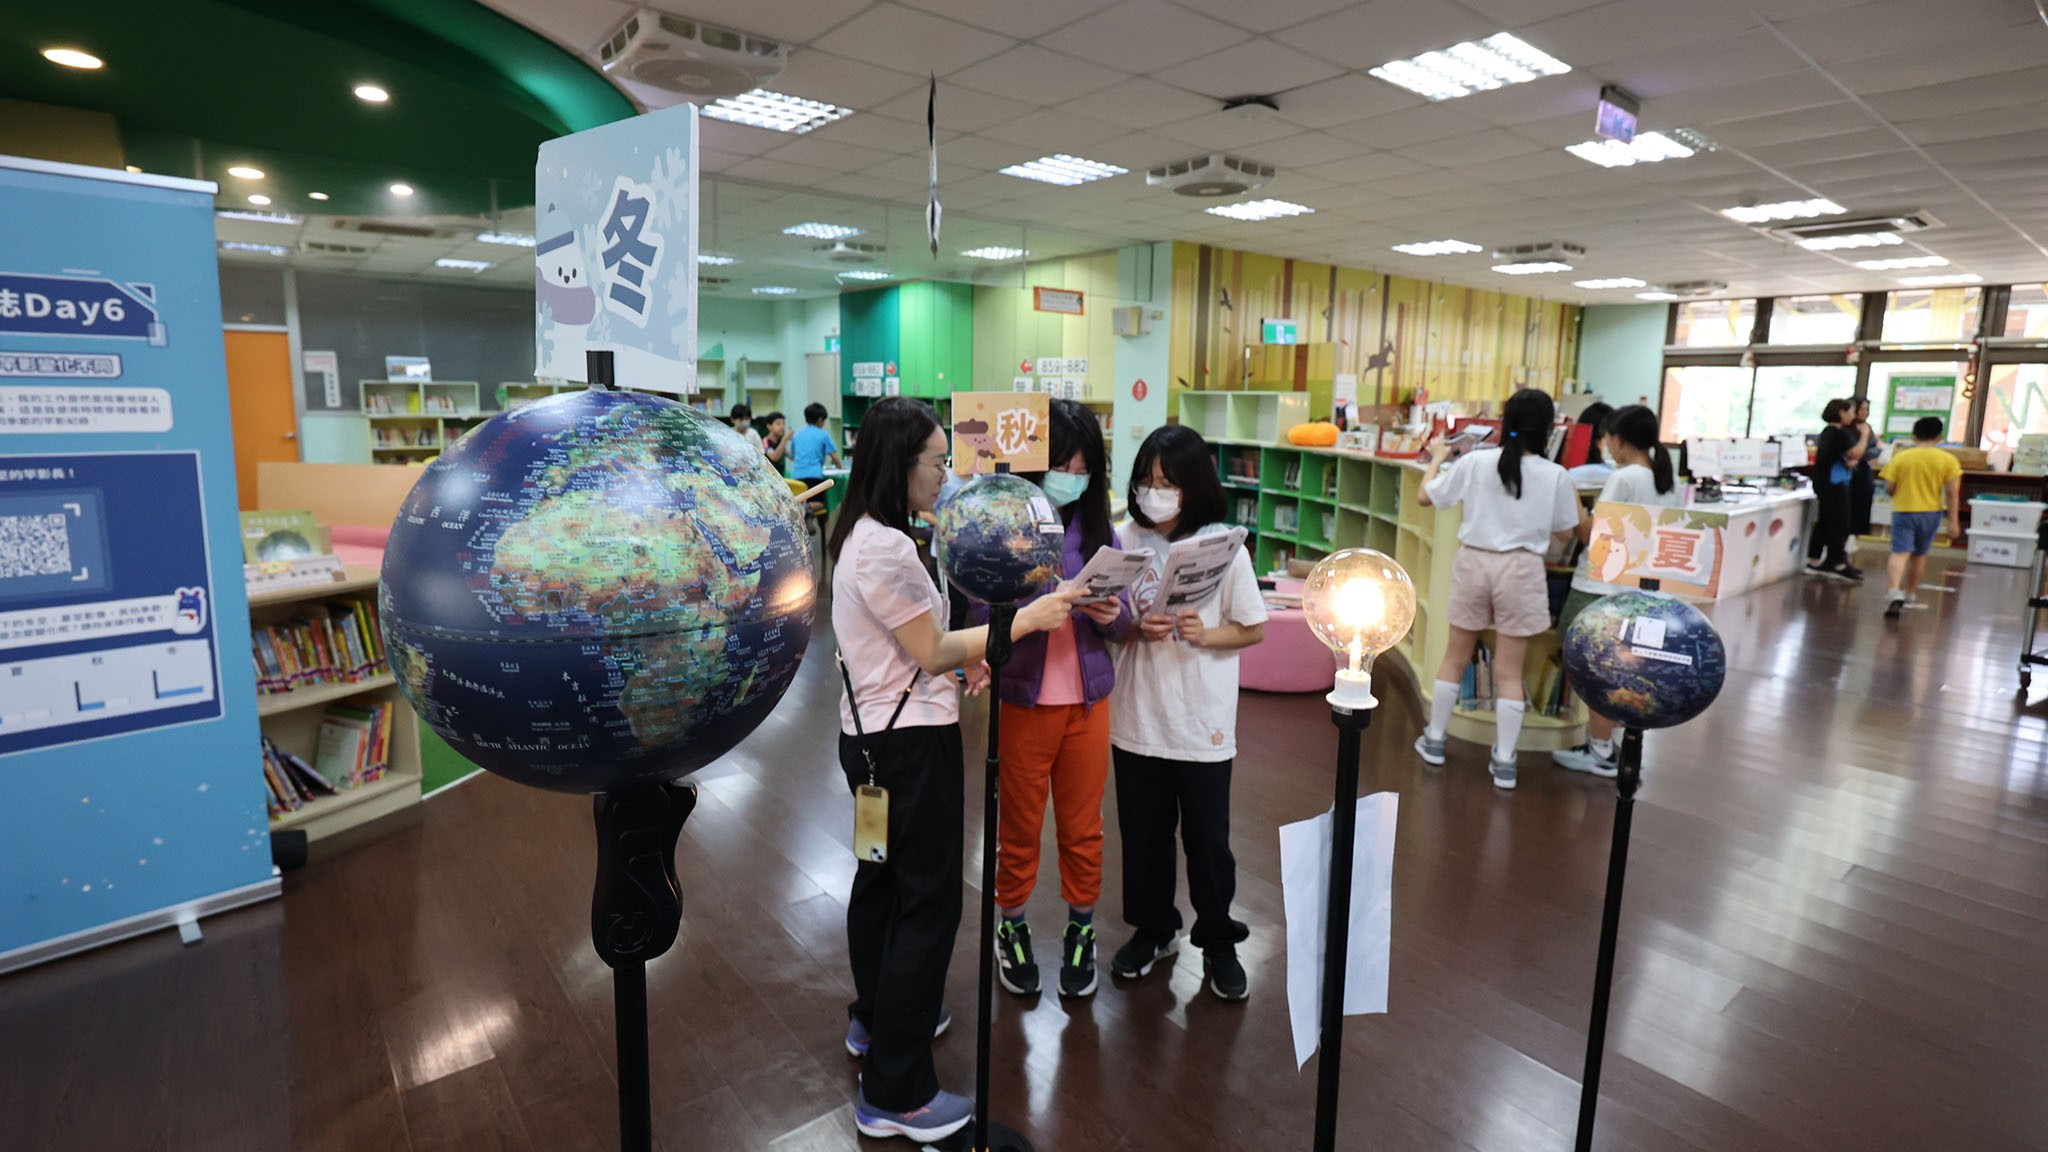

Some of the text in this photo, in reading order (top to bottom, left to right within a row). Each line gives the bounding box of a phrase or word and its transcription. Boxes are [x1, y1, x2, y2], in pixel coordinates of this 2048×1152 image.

[601, 188, 658, 316] 冬
[1000, 410, 1034, 453] 秋
[1652, 529, 1701, 573] 夏
